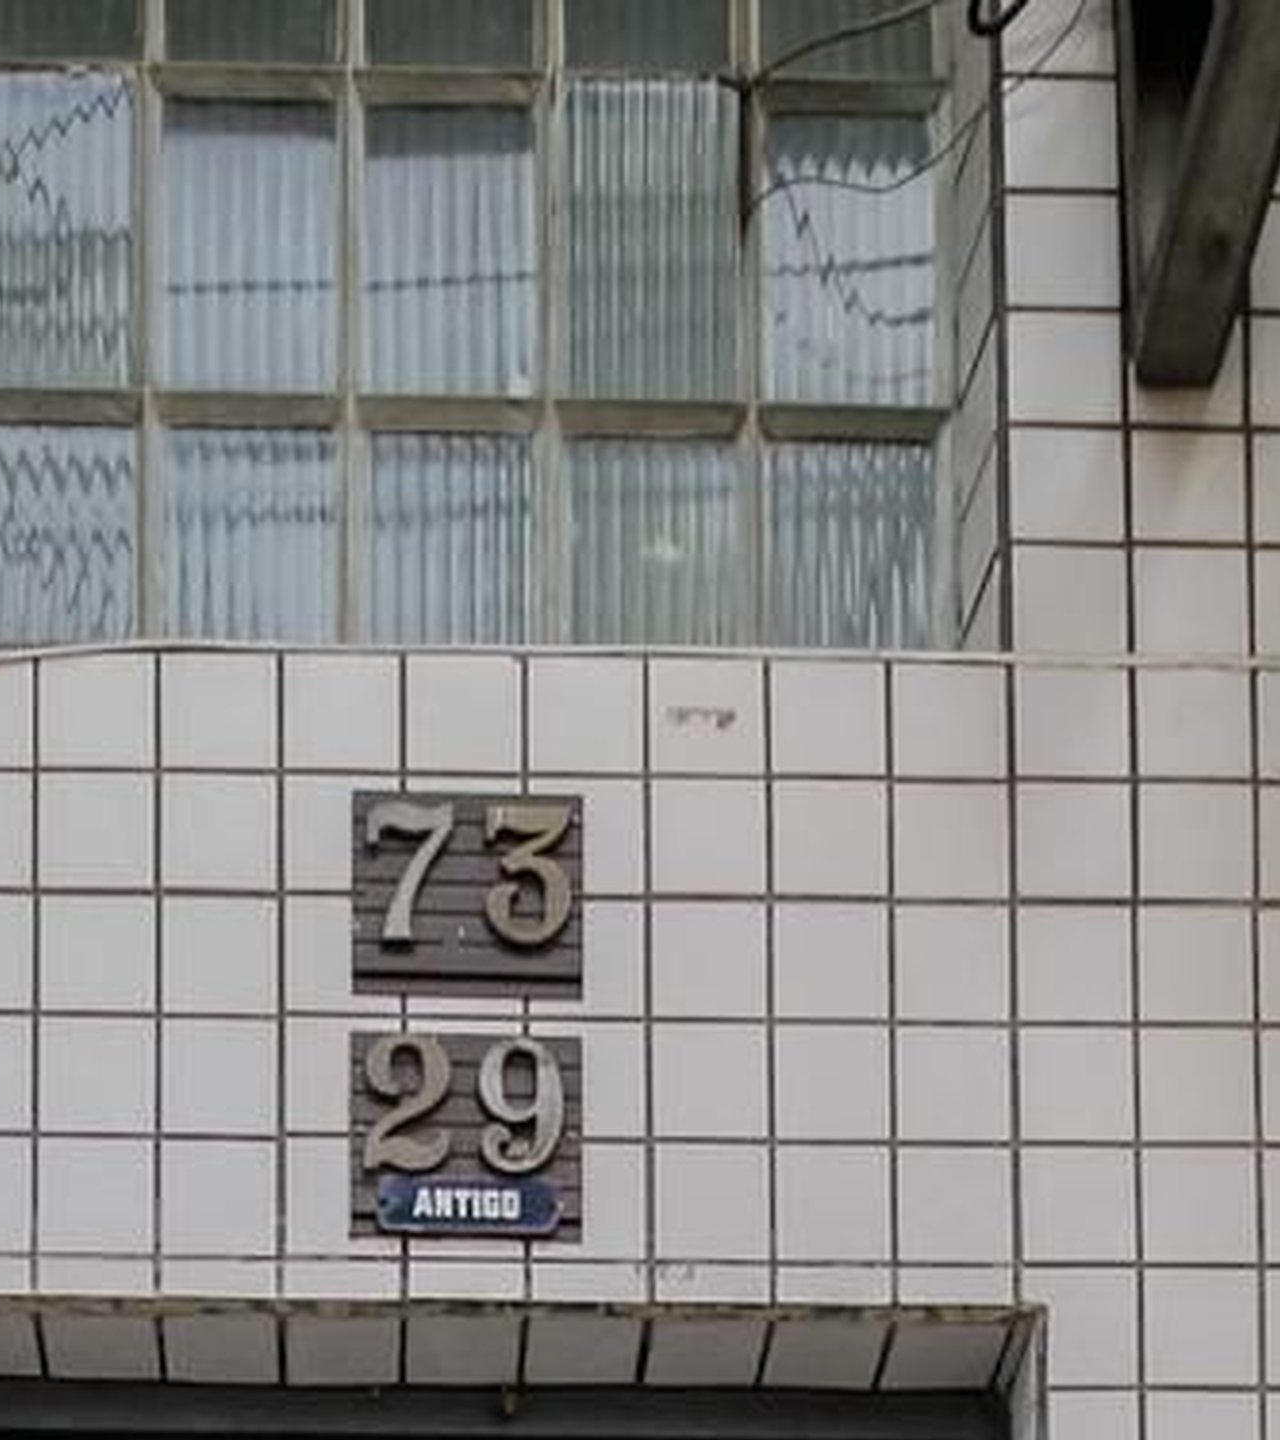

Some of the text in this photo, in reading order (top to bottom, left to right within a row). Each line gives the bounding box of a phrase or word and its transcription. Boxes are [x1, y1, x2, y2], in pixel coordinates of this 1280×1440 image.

[365, 800, 573, 948] 73
[365, 1035, 565, 1175] 29
[412, 1187, 522, 1220] ANTIGO
